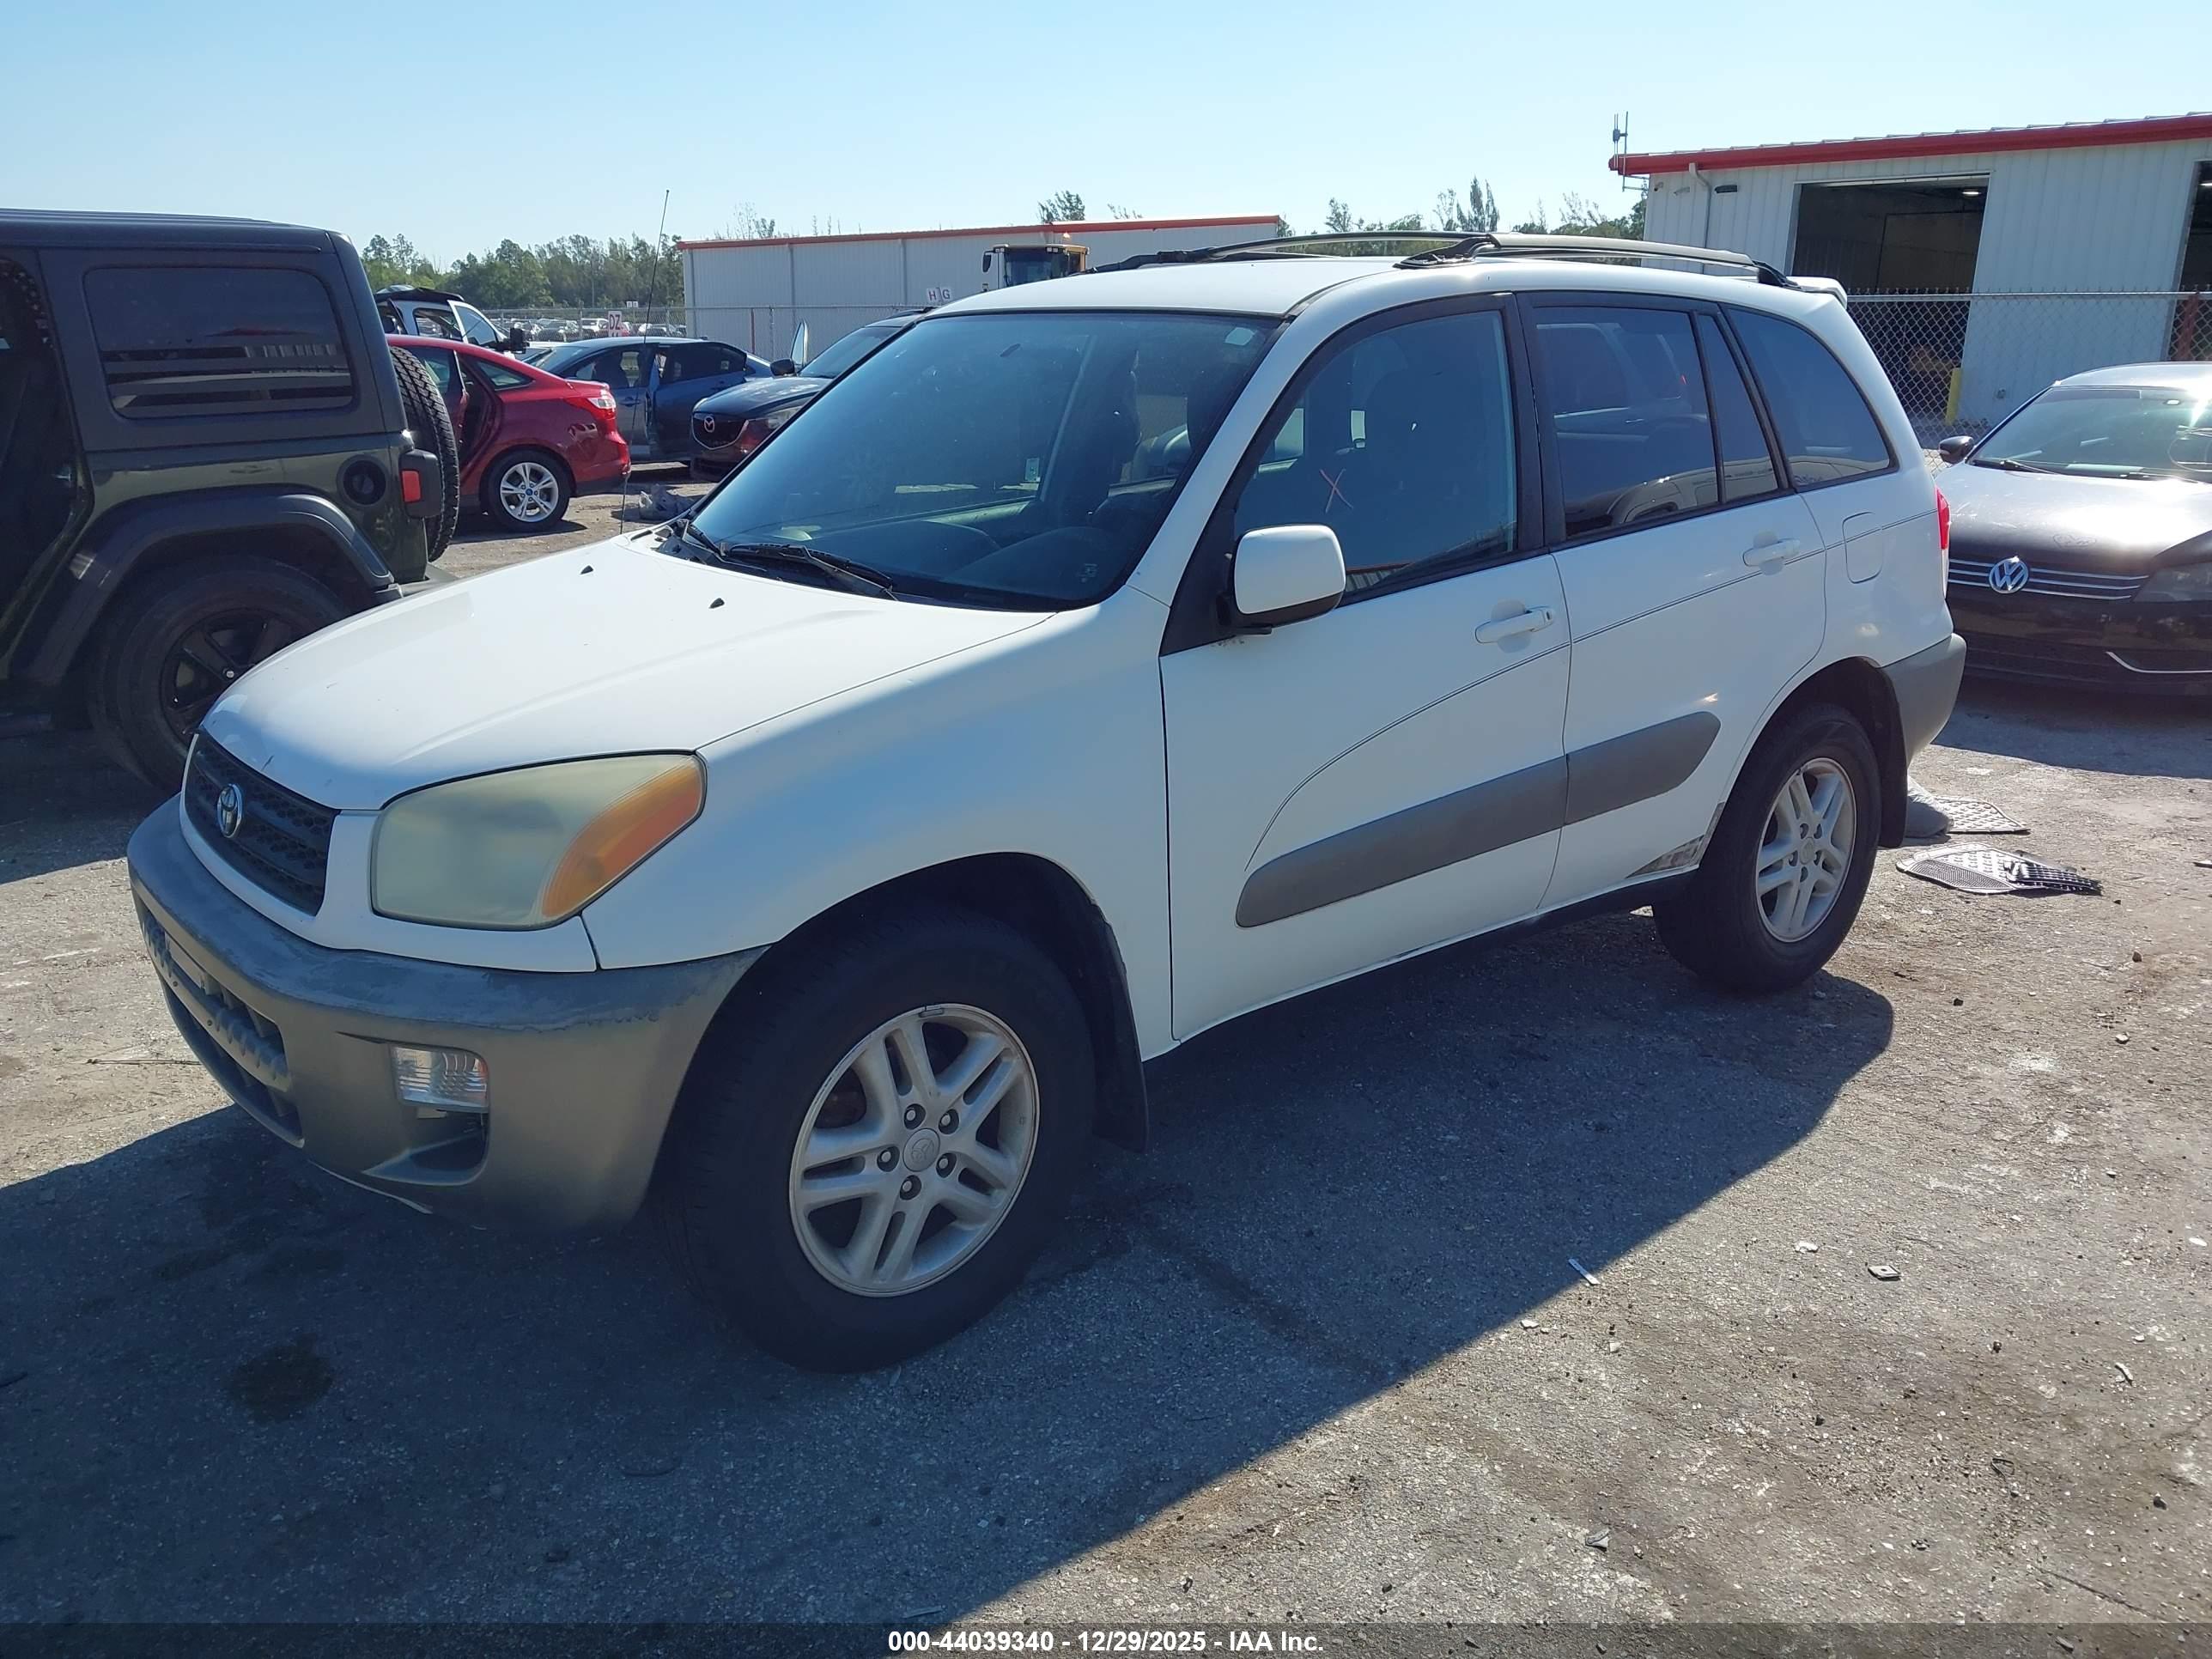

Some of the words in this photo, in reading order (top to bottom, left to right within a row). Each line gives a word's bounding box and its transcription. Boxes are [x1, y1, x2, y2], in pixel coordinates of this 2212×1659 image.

[928, 289, 937, 301] H
[942, 289, 951, 300] G
[609, 313, 621, 331] DZ
